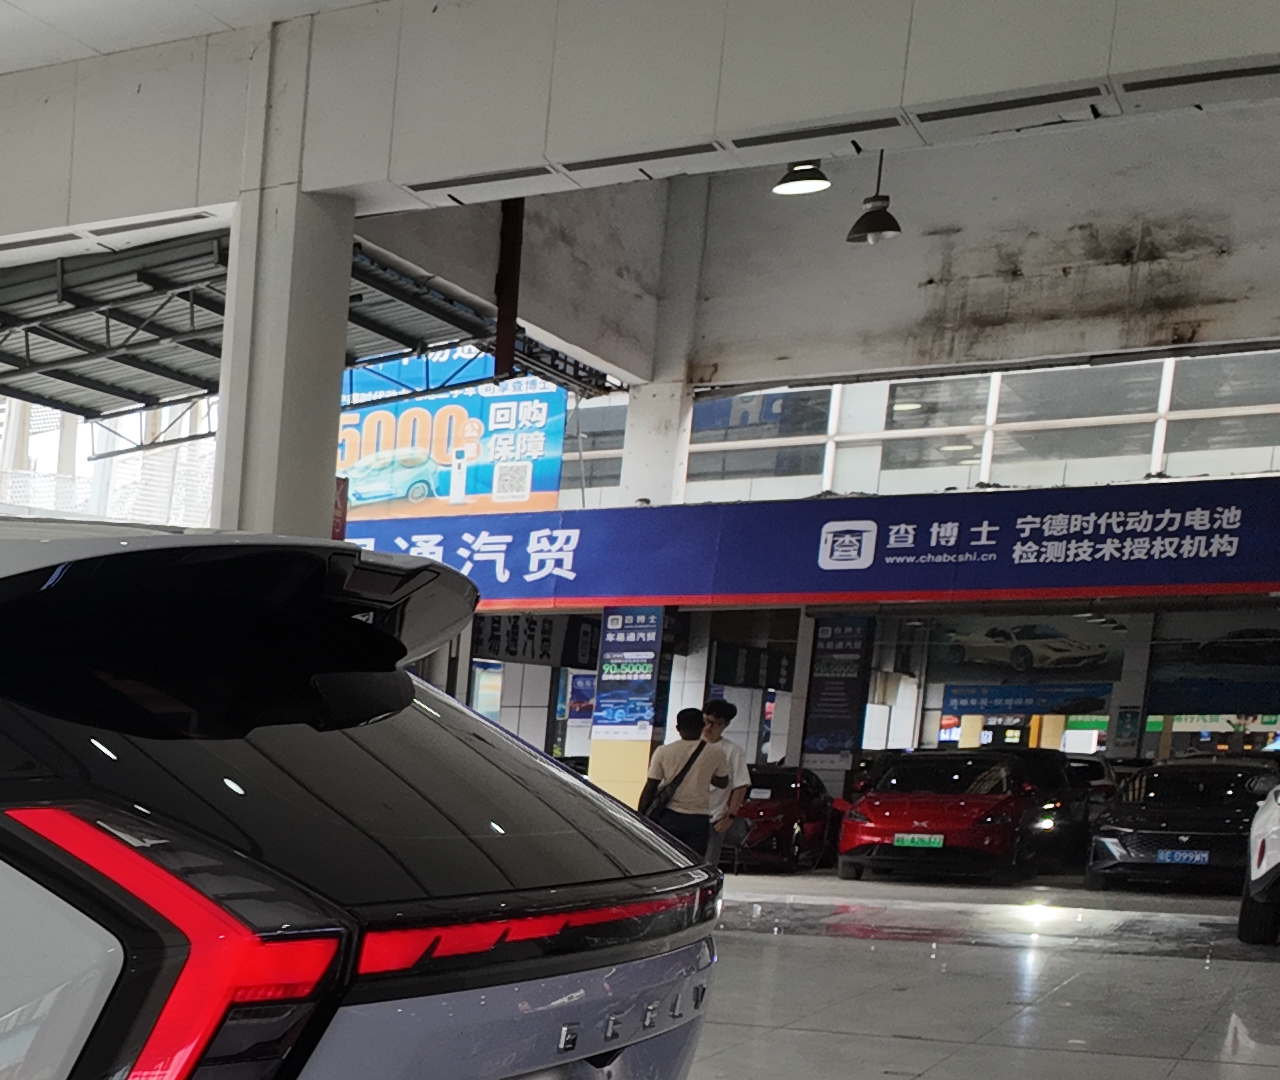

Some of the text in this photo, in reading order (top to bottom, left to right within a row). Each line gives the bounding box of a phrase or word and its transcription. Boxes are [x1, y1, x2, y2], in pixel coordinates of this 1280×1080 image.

[488, 399, 549, 431] 回购
[487, 431, 547, 462] 保障
[886, 520, 1000, 548] 查博士
[1015, 505, 1242, 538] 宁德时代动力电池
[1012, 533, 1239, 564] 检测技术授权机构
